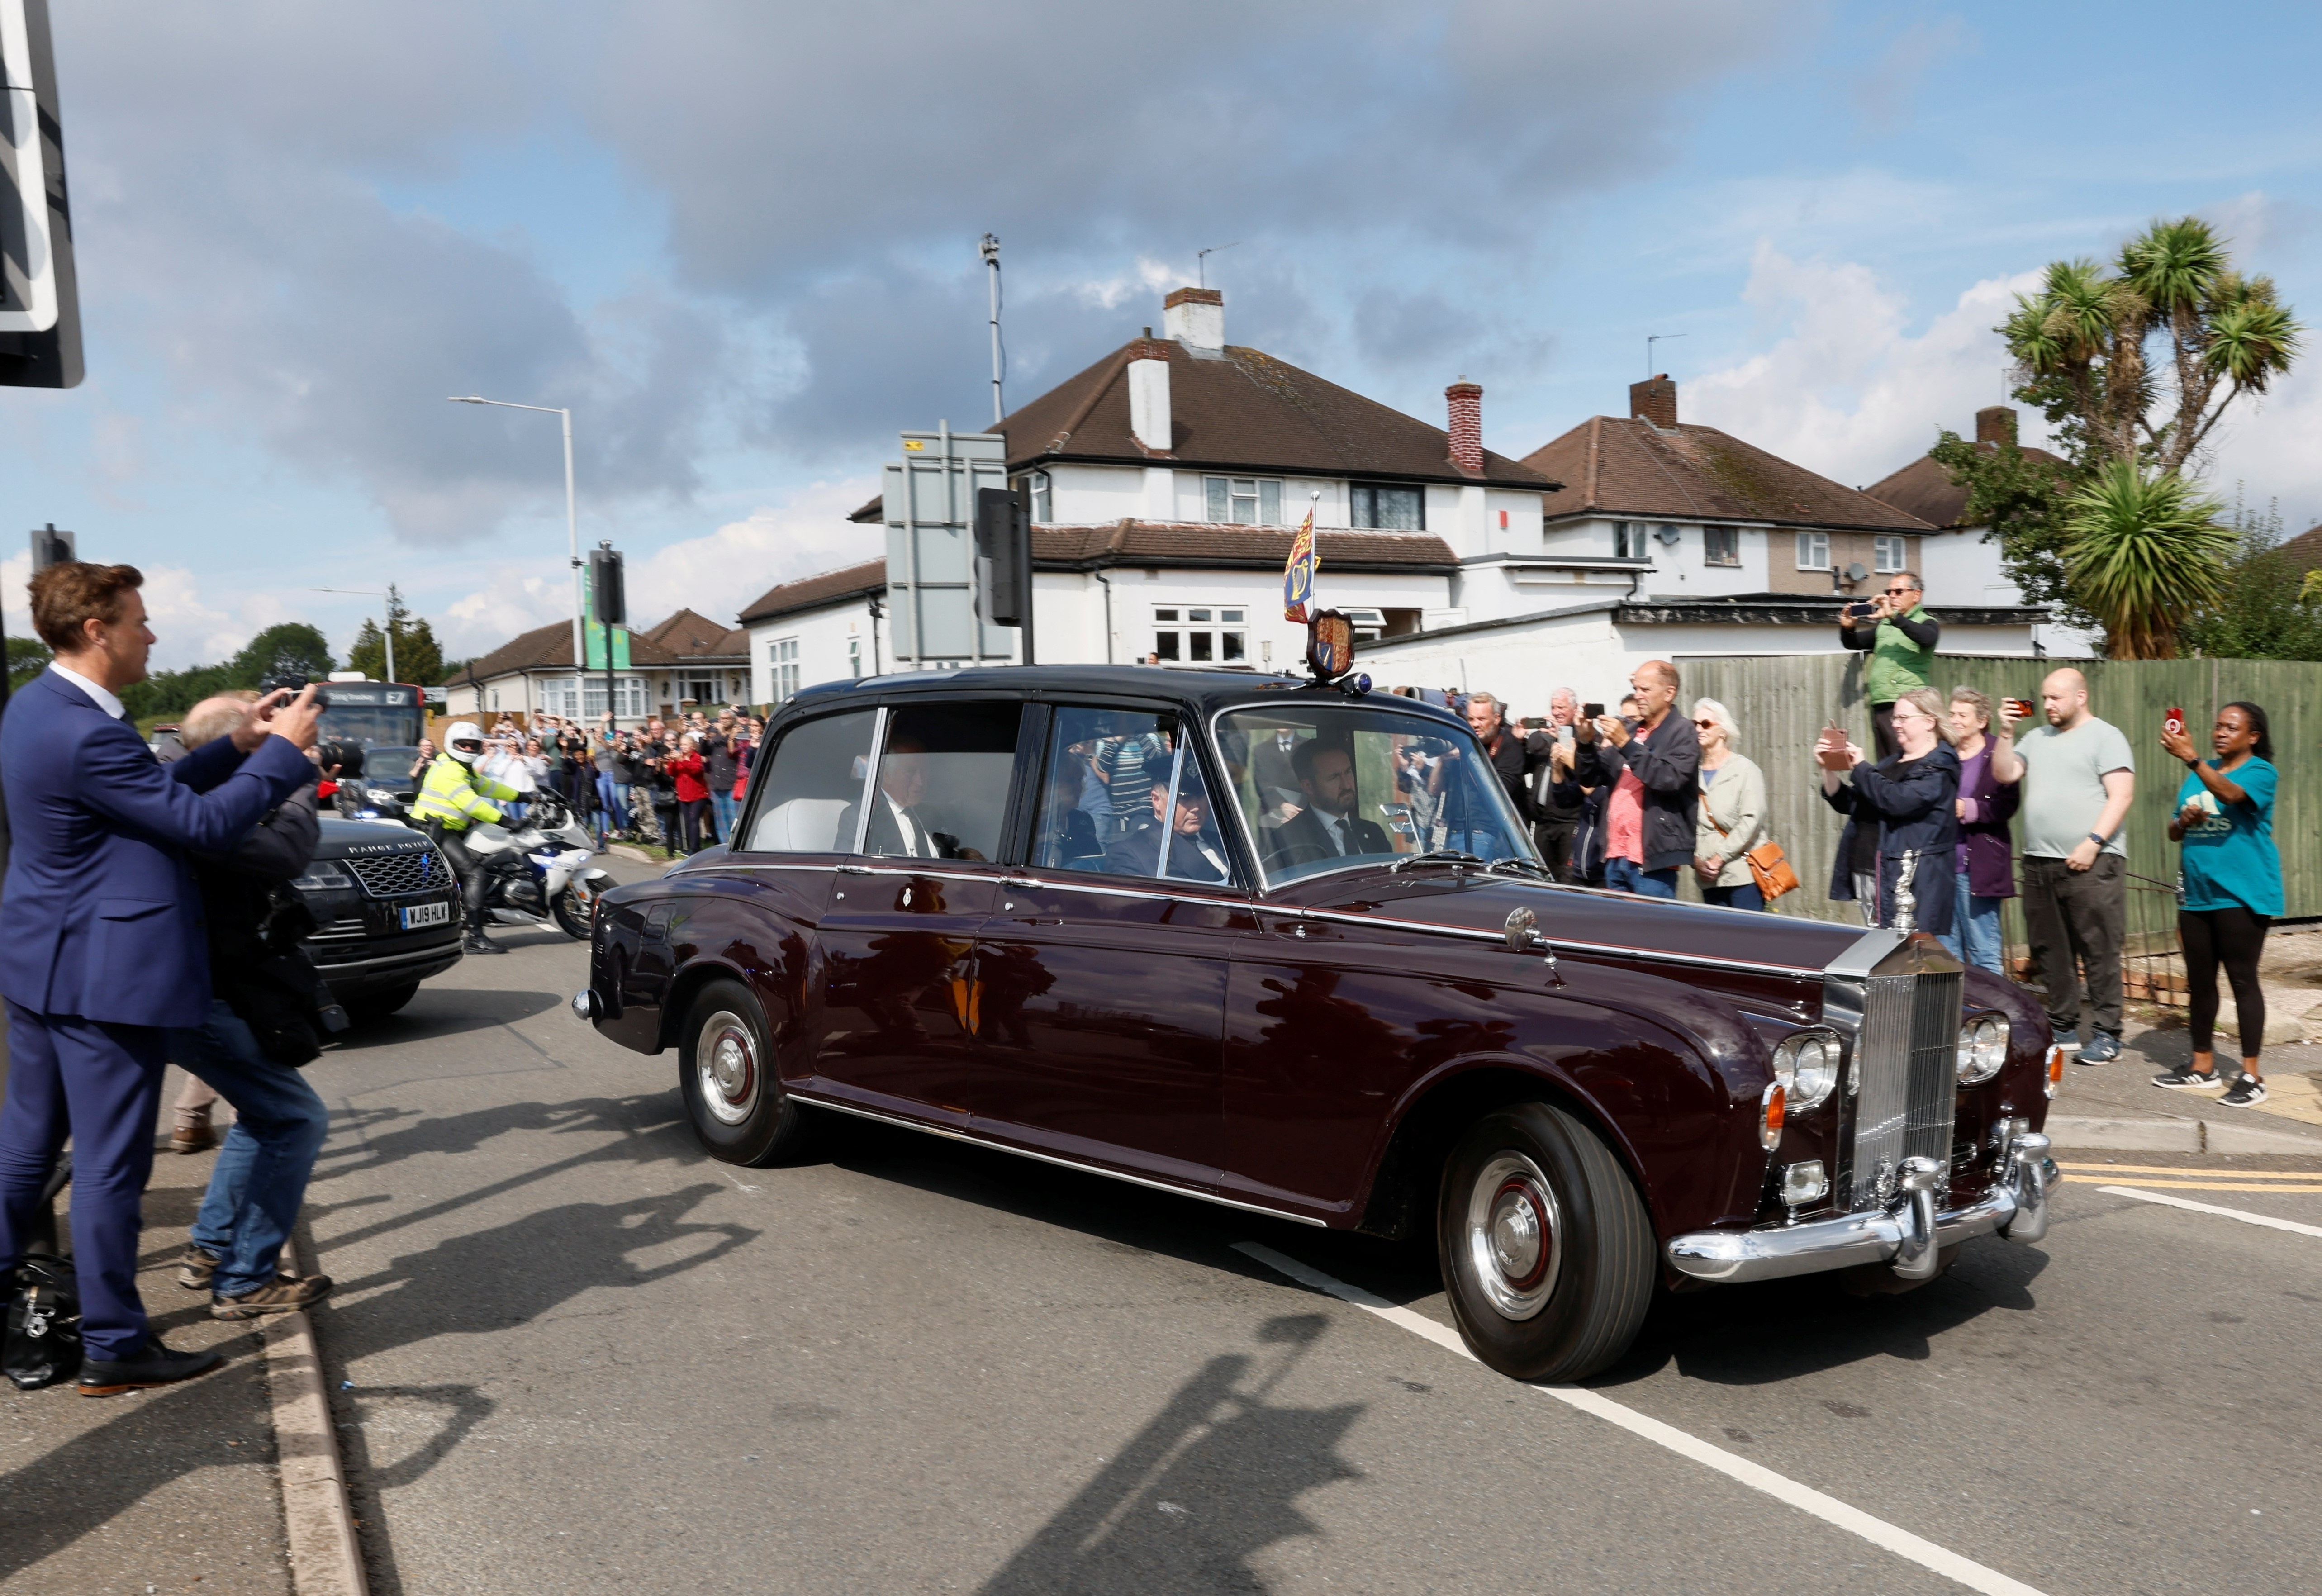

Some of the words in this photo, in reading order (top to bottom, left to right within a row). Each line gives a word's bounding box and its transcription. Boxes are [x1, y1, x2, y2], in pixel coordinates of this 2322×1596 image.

[386, 692, 405, 704] E7
[348, 845, 394, 854] RANGE
[398, 841, 429, 850] ROVER
[410, 907, 429, 924] WJ19
[432, 904, 445, 921] HLW
